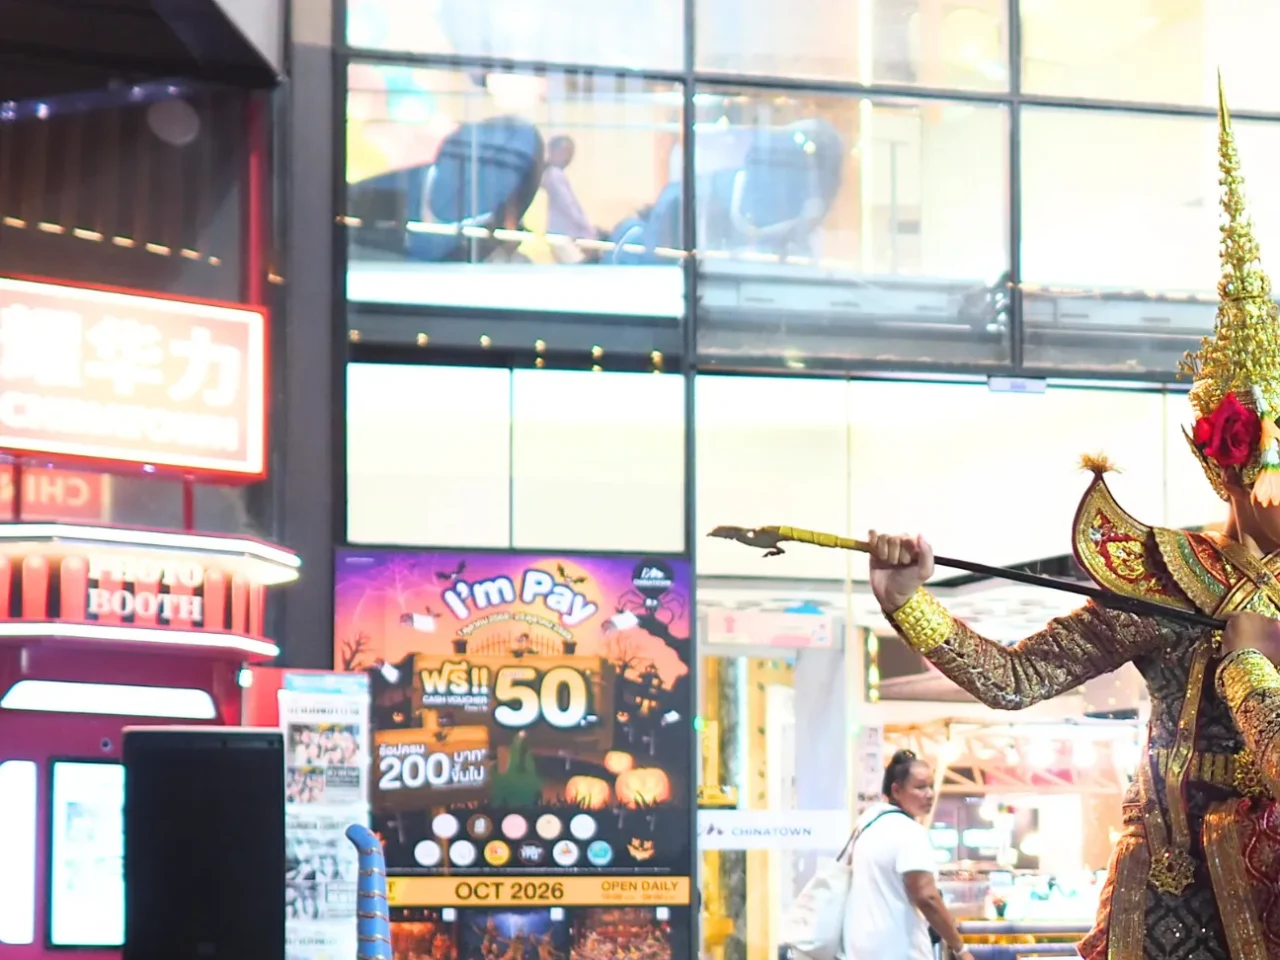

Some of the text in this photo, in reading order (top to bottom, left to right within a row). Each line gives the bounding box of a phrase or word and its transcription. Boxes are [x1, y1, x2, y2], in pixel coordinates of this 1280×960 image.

[88, 555, 204, 588] PHOTO
[88, 588, 203, 621] BOOTH
[444, 569, 598, 626] I'm Pay
[379, 752, 450, 790] 200
[731, 826, 812, 837] CHINATOWN
[455, 881, 564, 900] OCT 2026
[601, 881, 679, 891] OPEN DAILY
